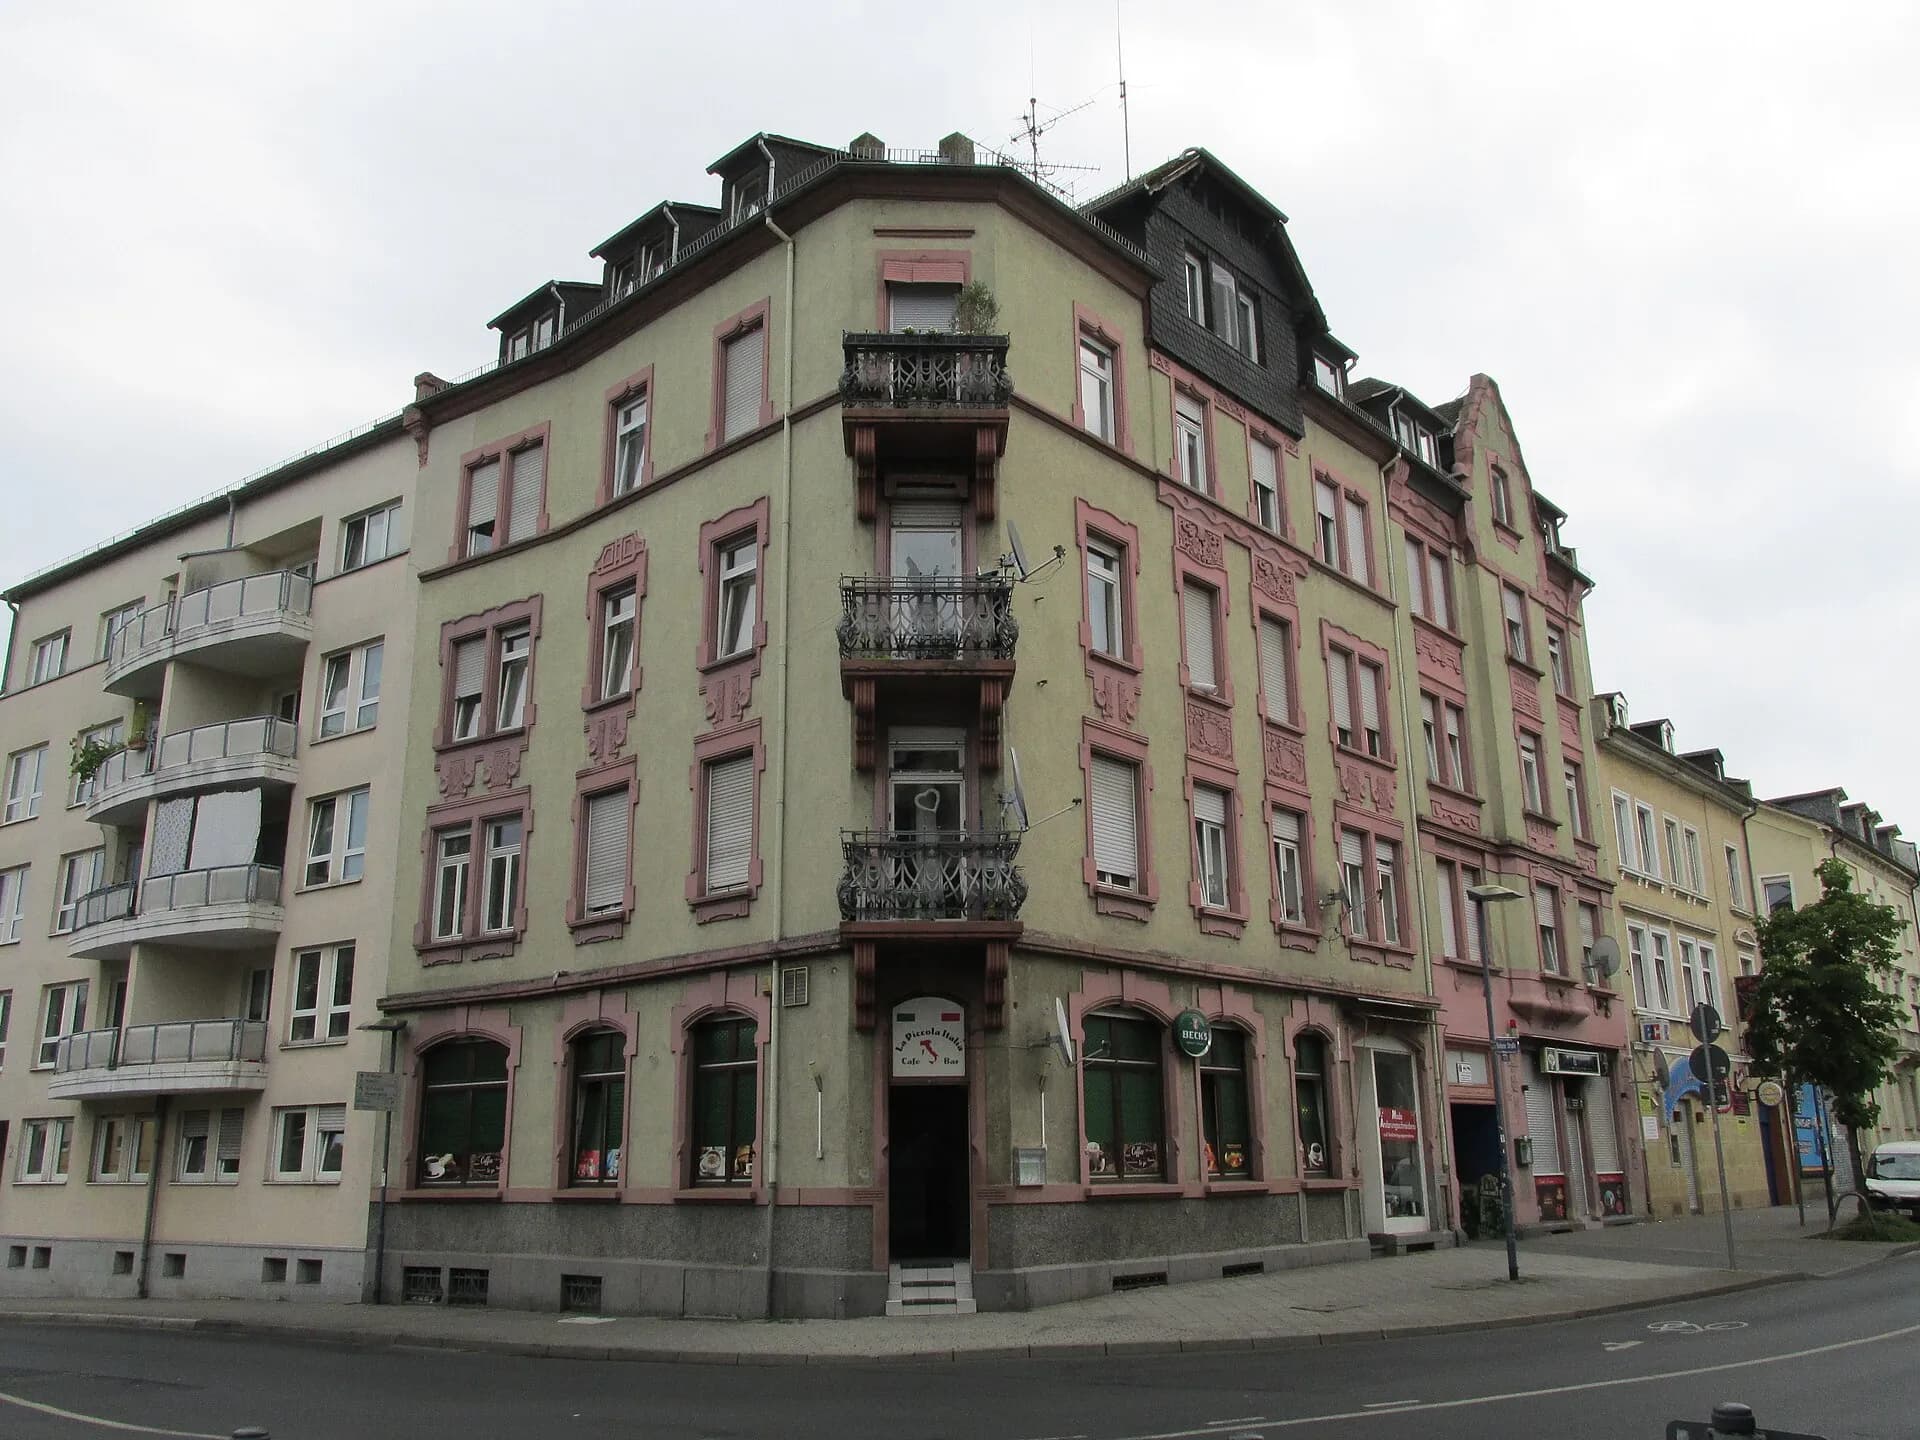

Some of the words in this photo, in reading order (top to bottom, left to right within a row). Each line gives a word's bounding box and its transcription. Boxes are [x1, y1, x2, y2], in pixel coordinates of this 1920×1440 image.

[895, 1040, 907, 1053] La
[905, 1027, 940, 1041] Piccola
[942, 1029, 963, 1052] Italia
[944, 1057, 959, 1065] Bar
